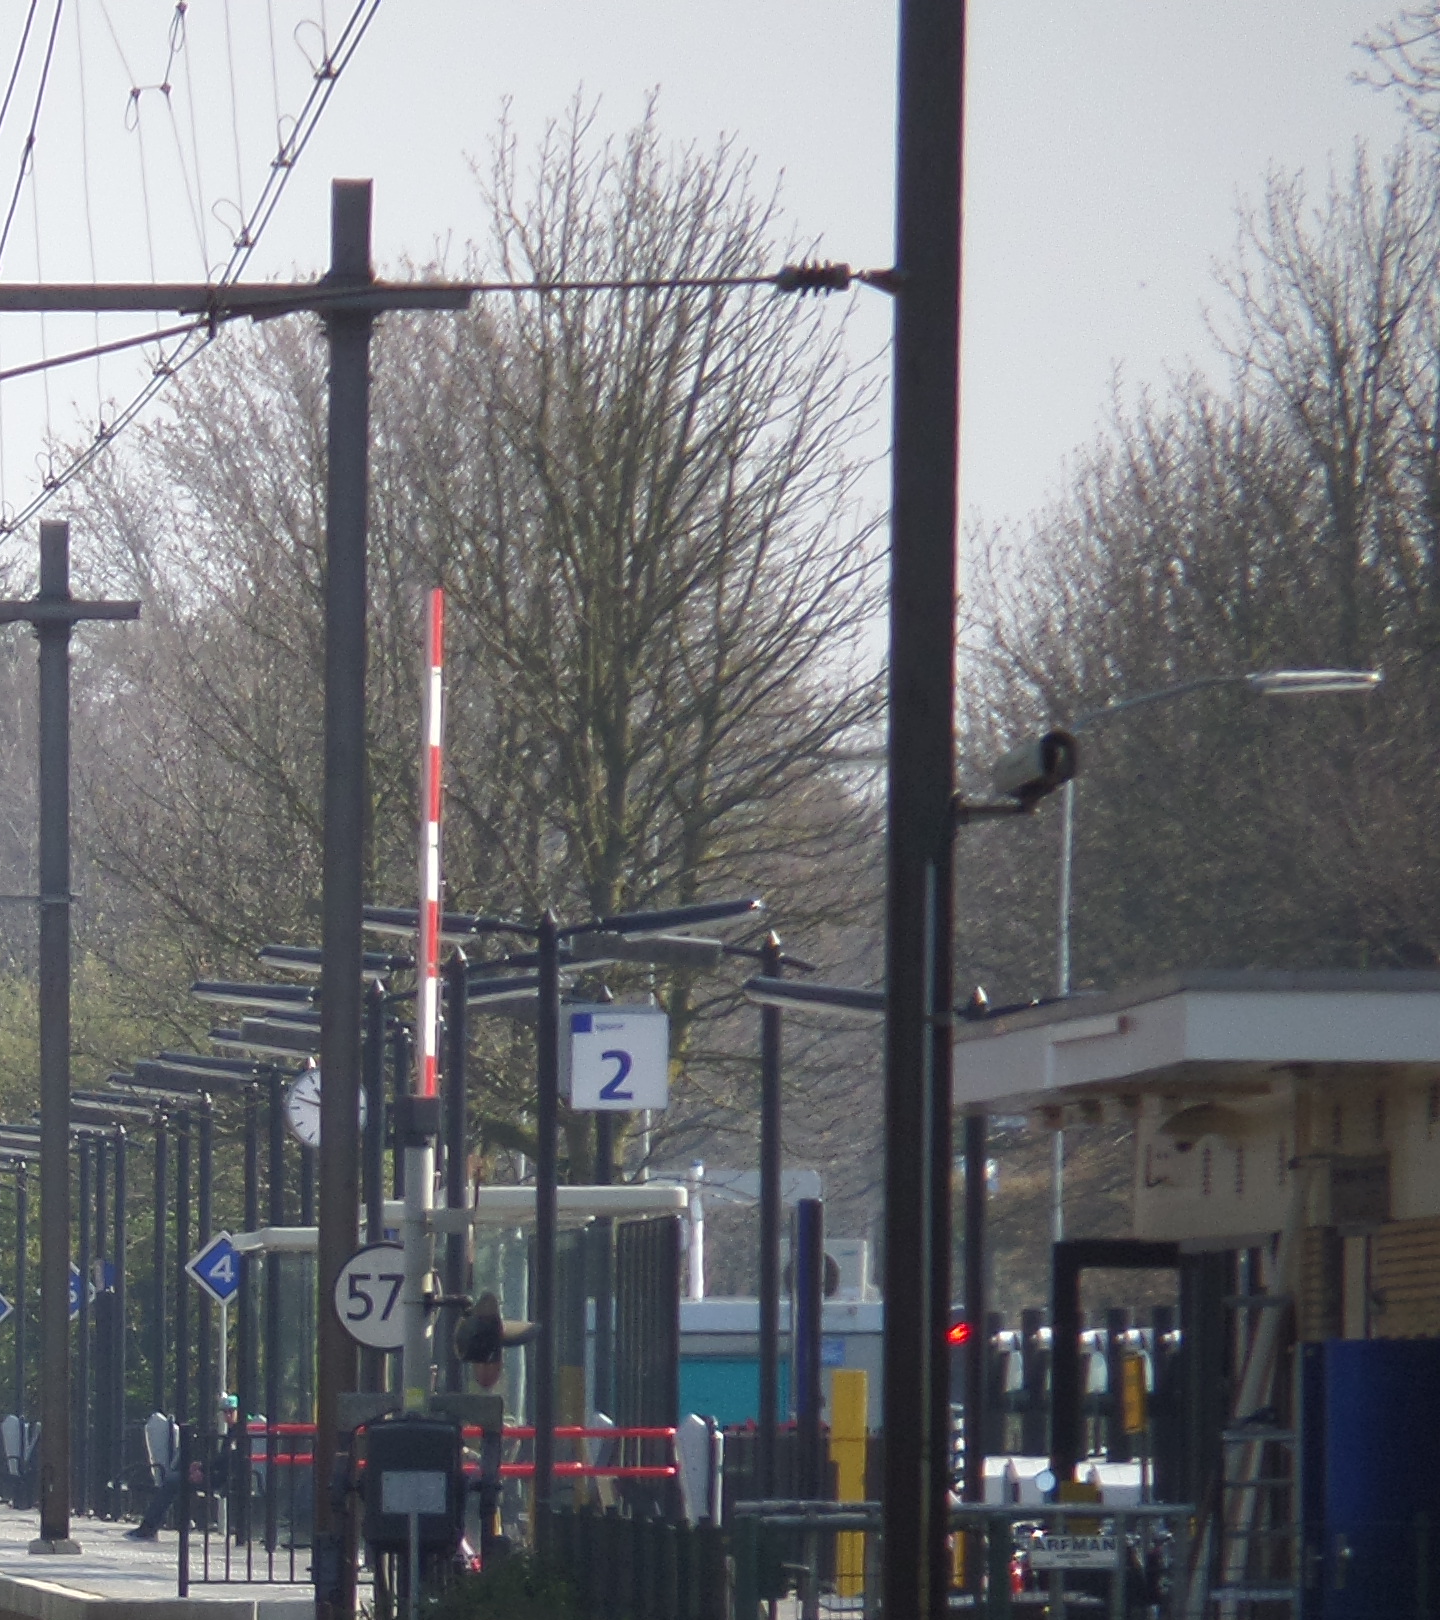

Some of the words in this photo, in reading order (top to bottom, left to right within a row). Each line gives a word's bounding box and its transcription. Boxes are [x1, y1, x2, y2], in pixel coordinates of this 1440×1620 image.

[600, 1050, 633, 1099] 2
[209, 1254, 234, 1283] 4
[347, 1273, 405, 1321] 57
